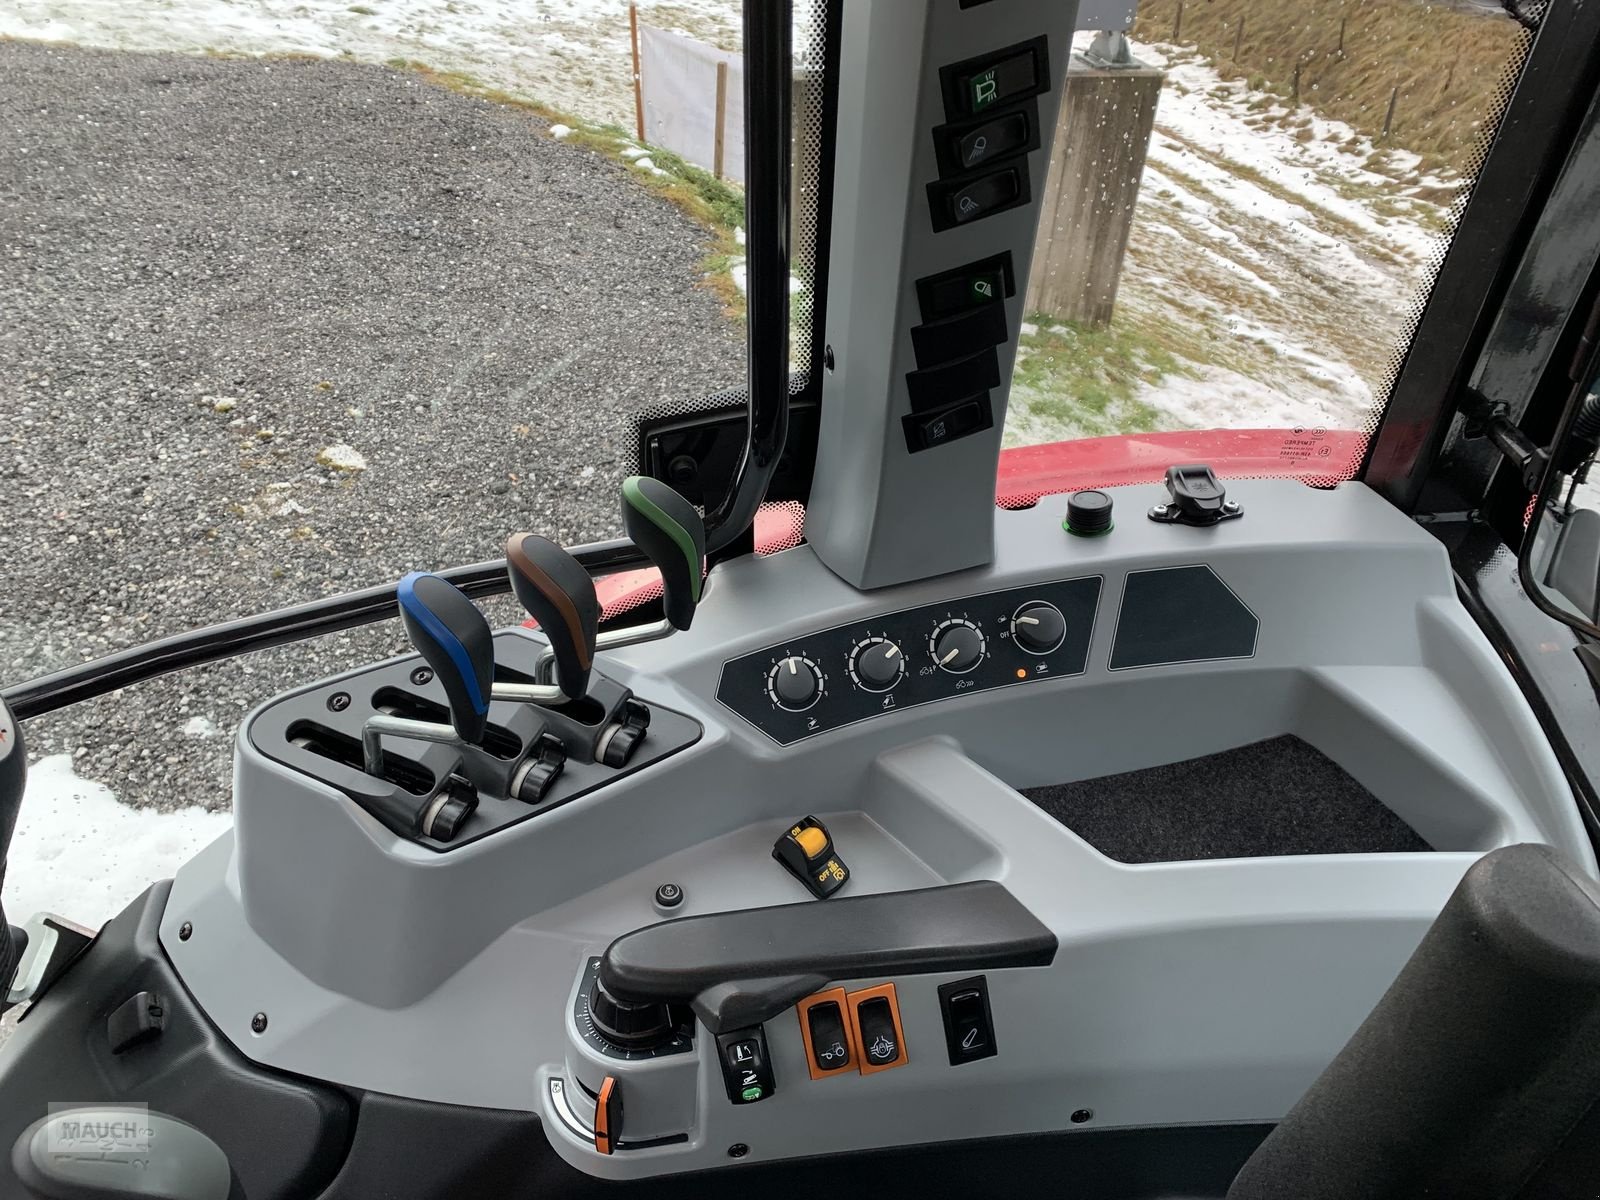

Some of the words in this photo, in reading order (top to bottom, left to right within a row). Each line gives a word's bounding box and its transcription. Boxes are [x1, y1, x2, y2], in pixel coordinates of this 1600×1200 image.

[1000, 630, 1010, 639] OFF
[791, 826, 802, 836] ON
[819, 869, 831, 882] OFF
